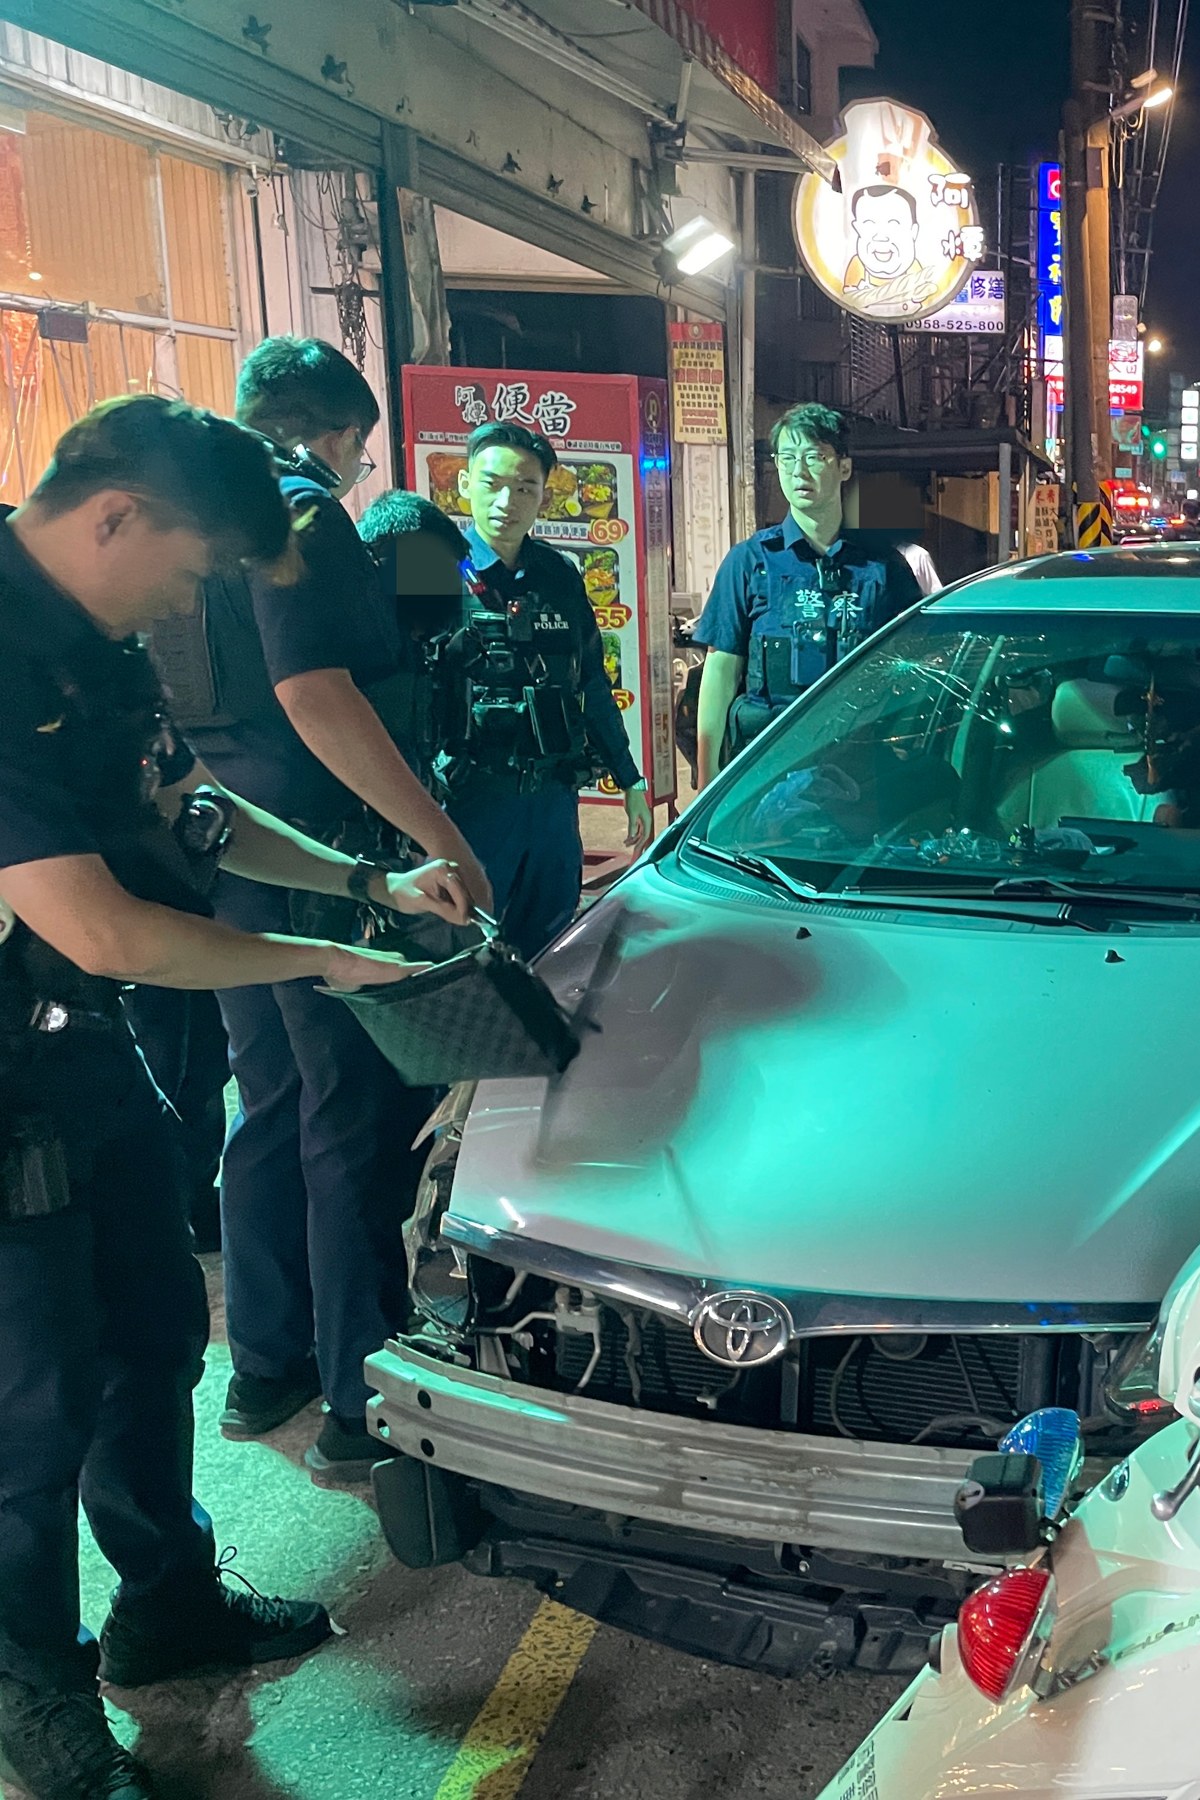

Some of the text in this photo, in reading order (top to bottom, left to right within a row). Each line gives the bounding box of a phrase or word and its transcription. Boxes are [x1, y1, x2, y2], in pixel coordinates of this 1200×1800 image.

[905, 319, 1004, 331] 0958-525-800
[593, 519, 624, 542] 69
[794, 589, 864, 619] 警察
[533, 621, 570, 630] POLICE
[595, 605, 628, 628] 55
